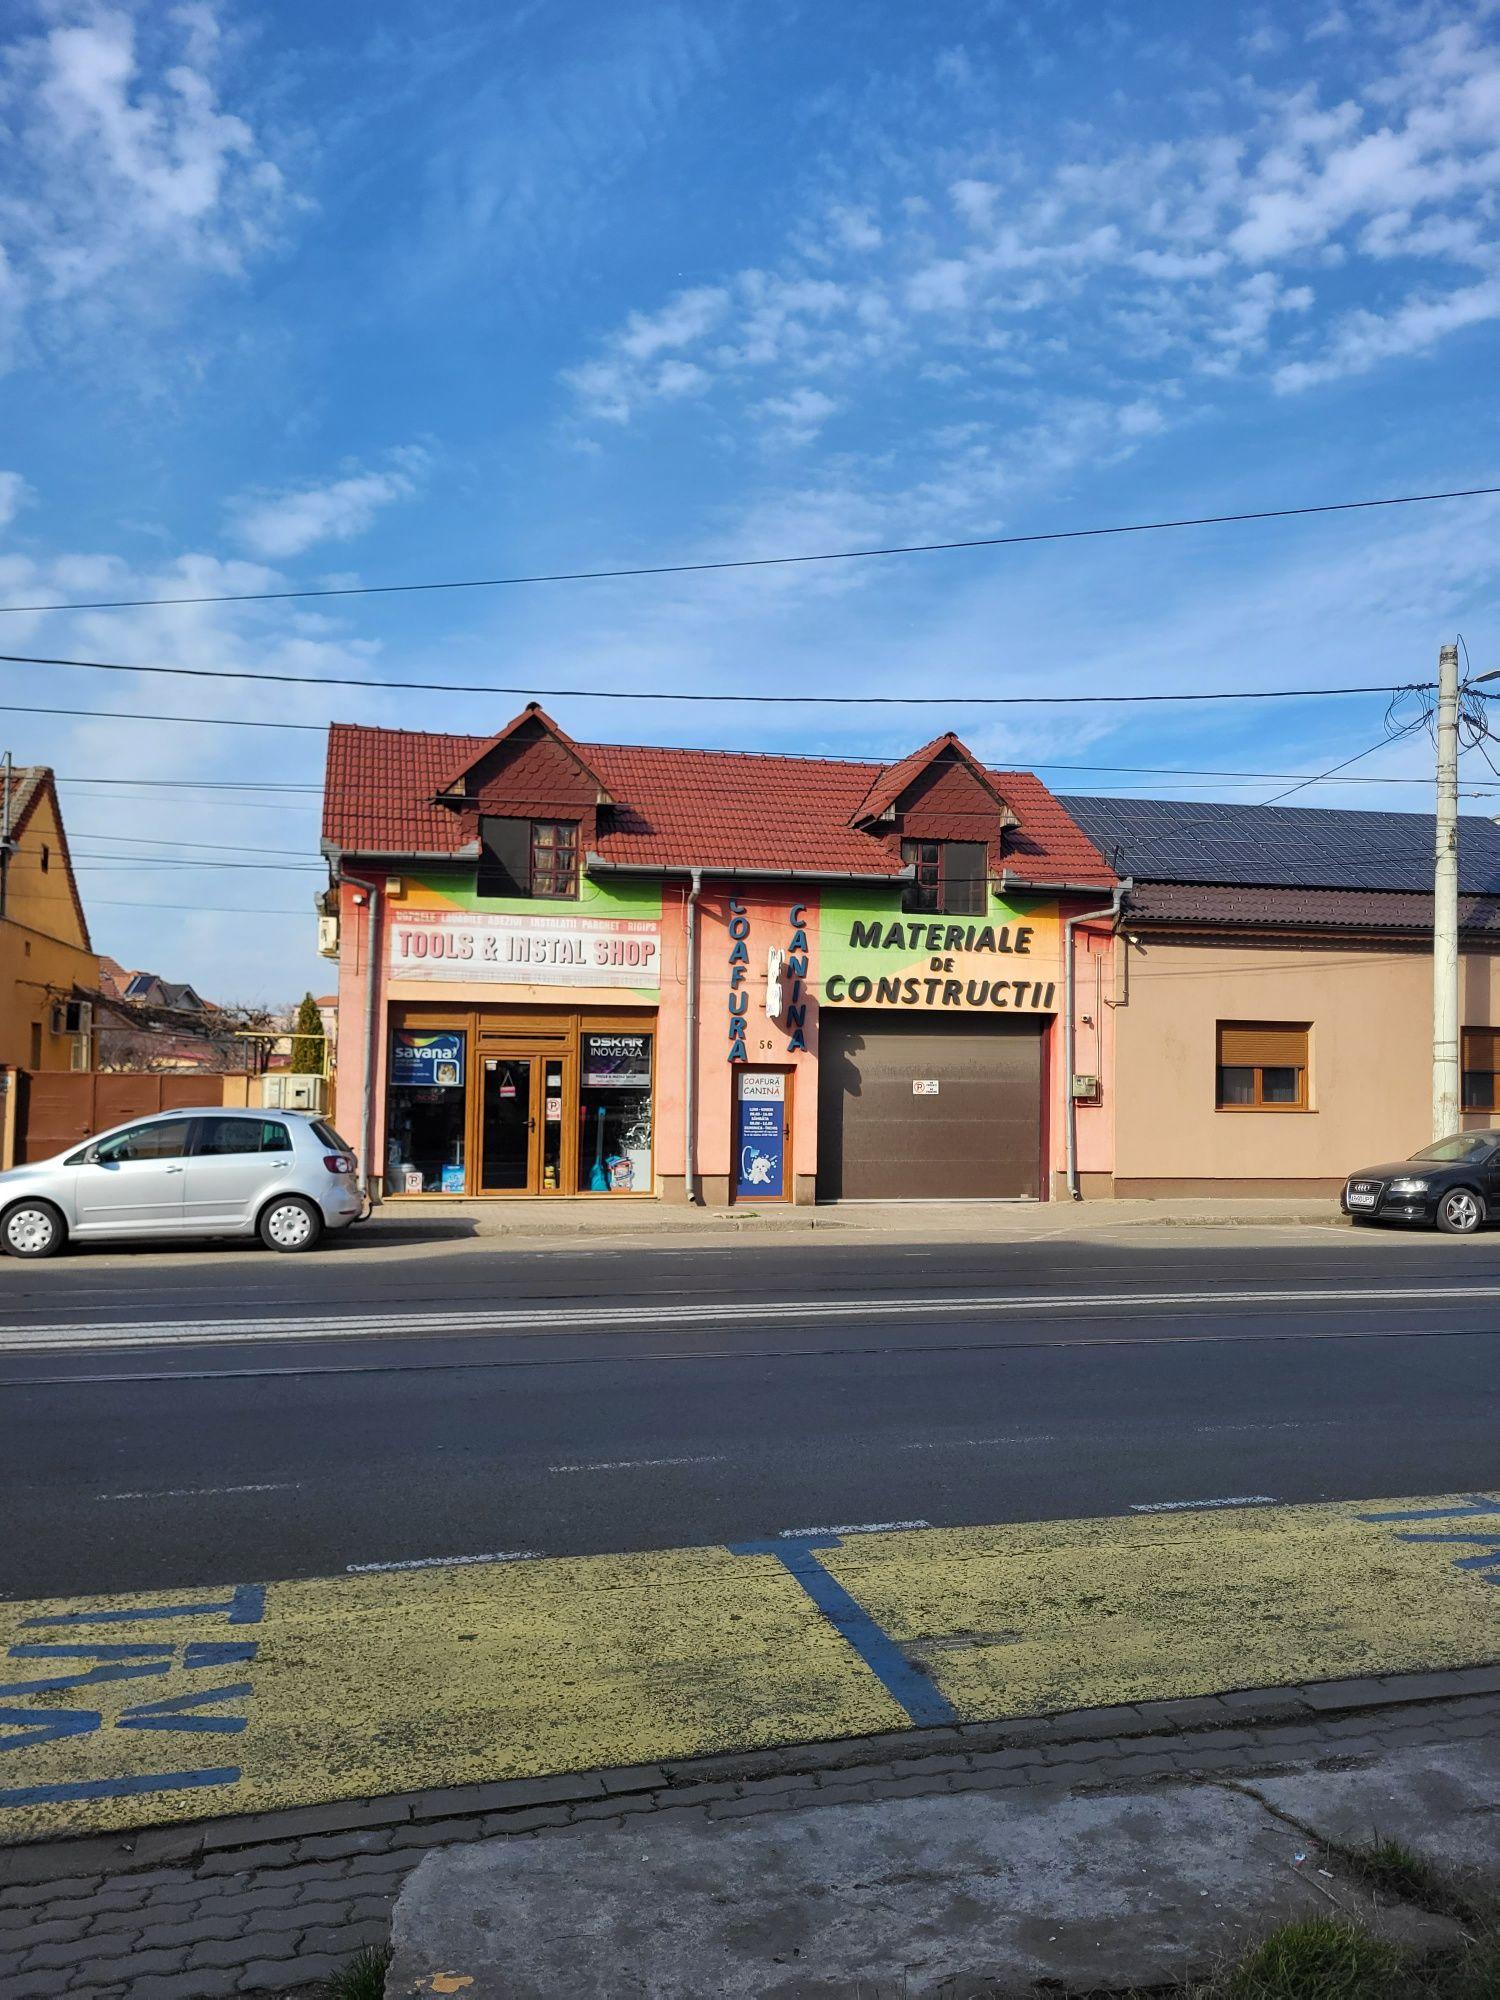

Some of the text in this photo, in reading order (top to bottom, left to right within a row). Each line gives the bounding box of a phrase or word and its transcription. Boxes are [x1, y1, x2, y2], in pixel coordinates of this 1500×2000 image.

[627, 921, 657, 932] RIGIPS
[848, 920, 1035, 954] MATERIALE
[399, 930, 656, 967] TOOLS & INSTAL SHOP
[929, 956, 956, 973] DE
[727, 893, 751, 1063] COAFURA
[786, 903, 809, 1053] CANINA
[825, 974, 1056, 1009] CONSTRUCTII
[395, 1046, 452, 1059] savana
[589, 1037, 643, 1047] OSKAR
[759, 1040, 773, 1050] 56
